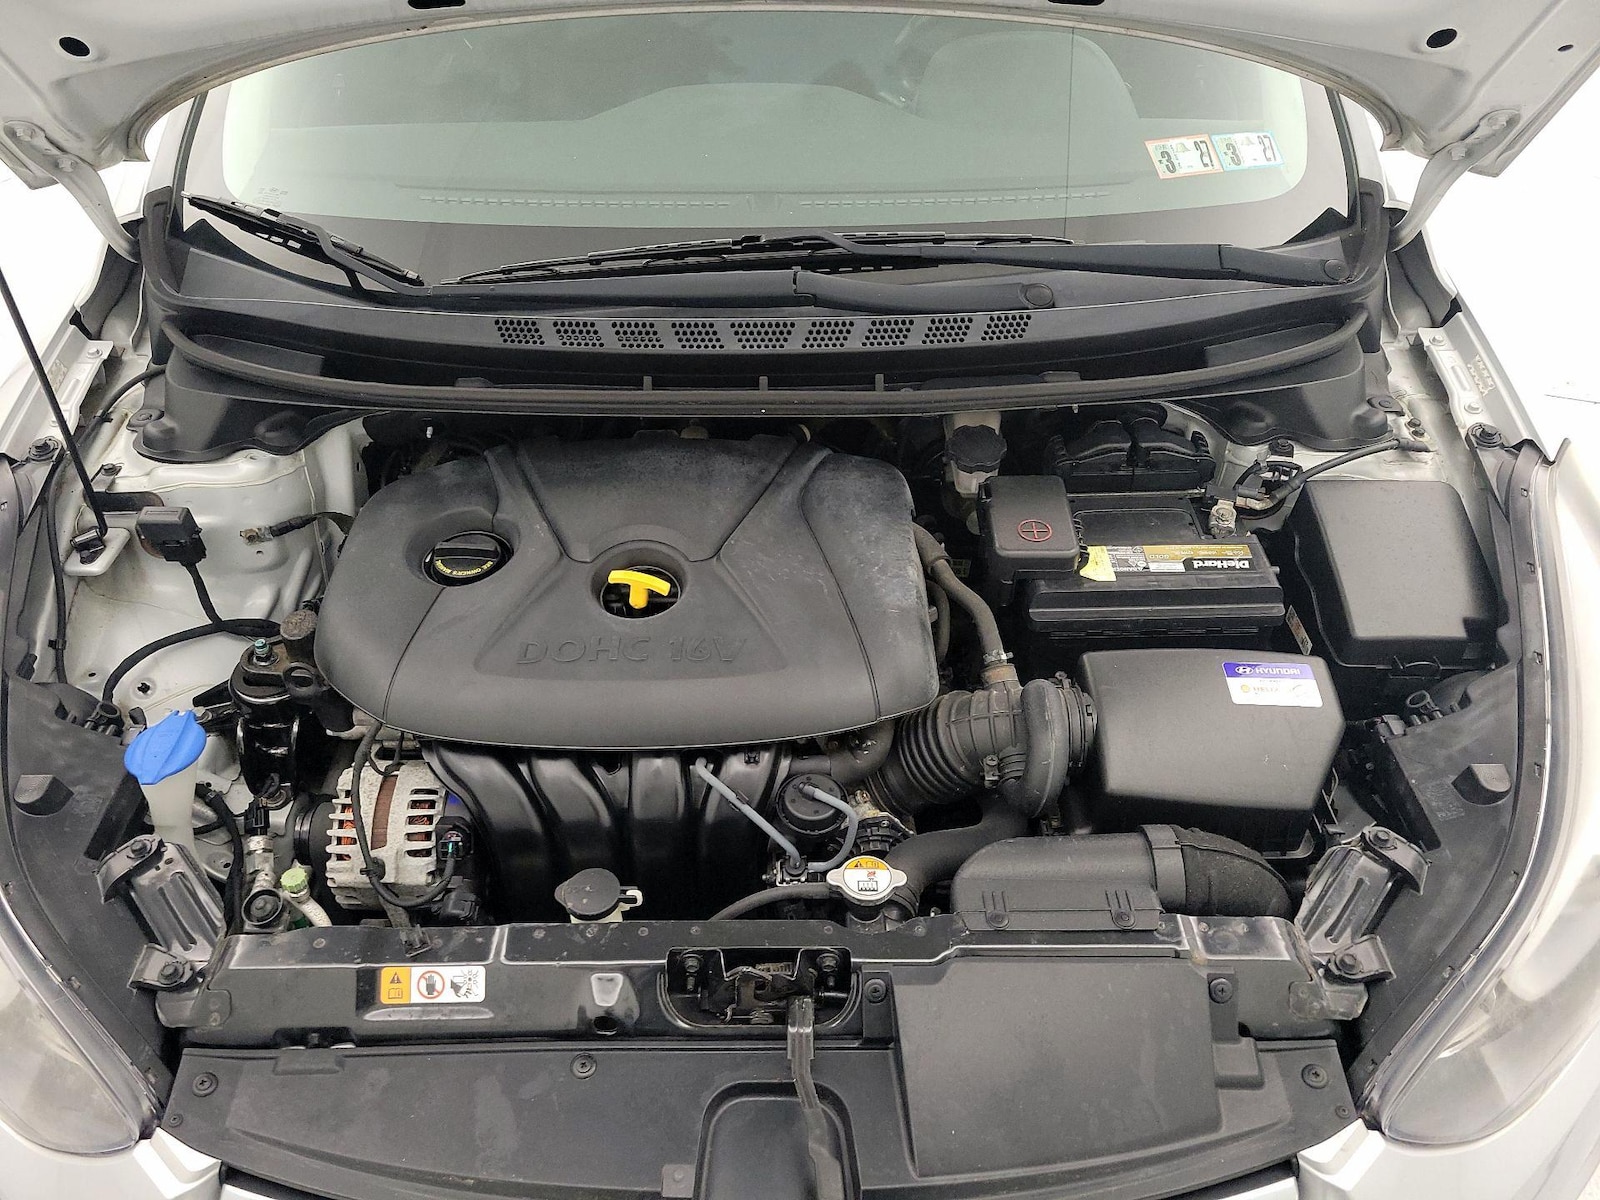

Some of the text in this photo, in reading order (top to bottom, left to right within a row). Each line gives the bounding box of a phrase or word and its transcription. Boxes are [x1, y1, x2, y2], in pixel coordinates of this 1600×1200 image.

[1161, 151, 1176, 173] 3
[1194, 141, 1214, 167] 27
[1226, 142, 1241, 165] 3
[1192, 560, 1250, 569] DieHard
[516, 635, 748, 664] DOHC 16V
[1255, 667, 1301, 675] HYUNDAI
